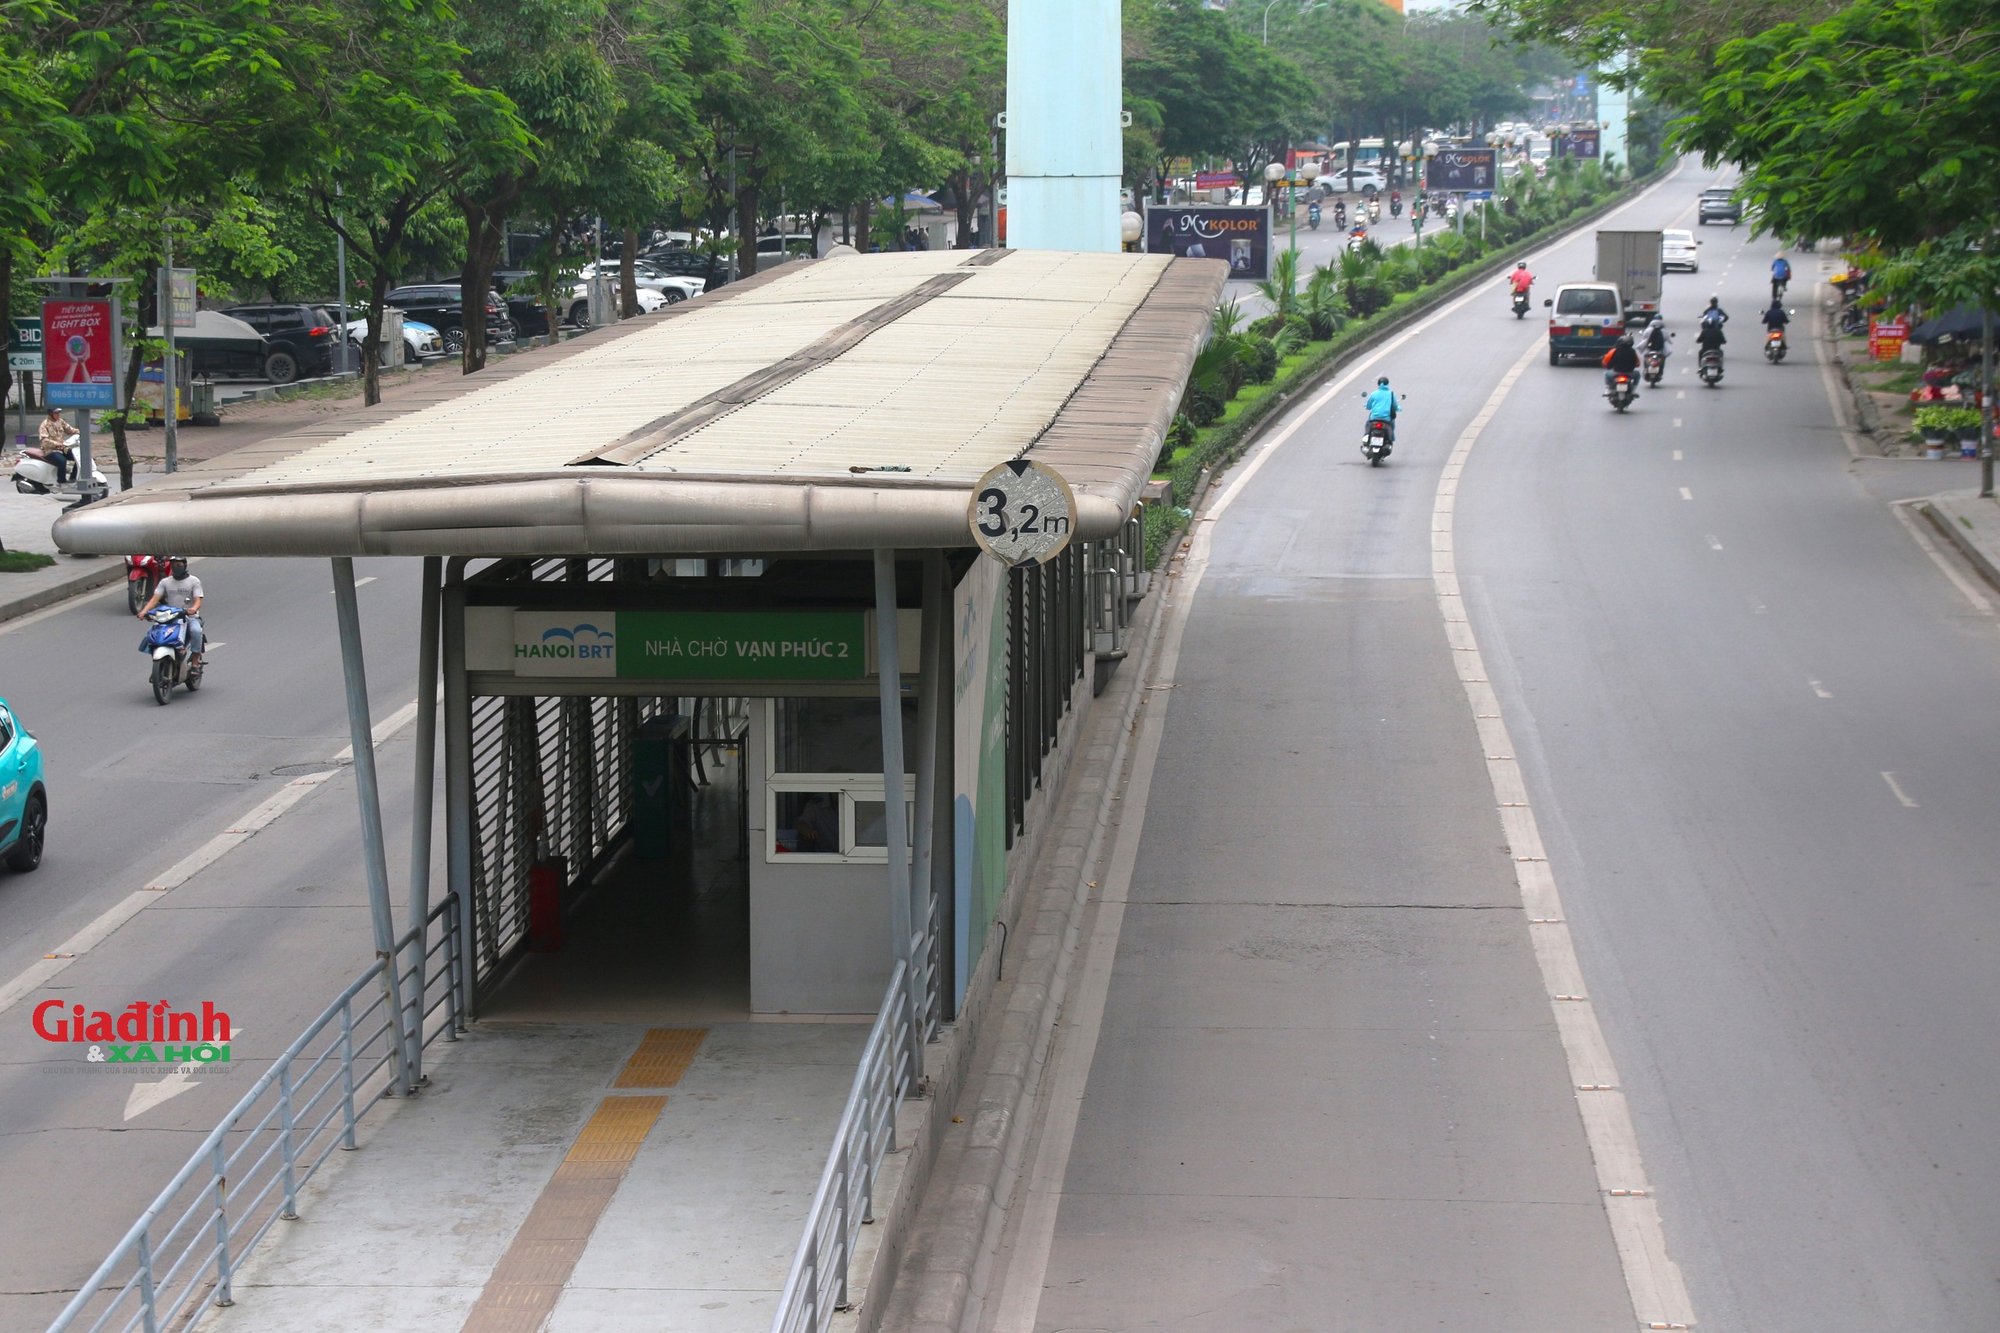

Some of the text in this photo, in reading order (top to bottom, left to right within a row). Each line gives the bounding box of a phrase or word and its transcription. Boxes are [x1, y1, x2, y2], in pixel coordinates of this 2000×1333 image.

[51, 318, 102, 329] LIGHT BOX
[51, 390, 72, 398] 0865
[514, 644, 614, 659] HANOI BRT
[645, 636, 849, 662] NHÀ CHỜ VẠN PHÚC 2
